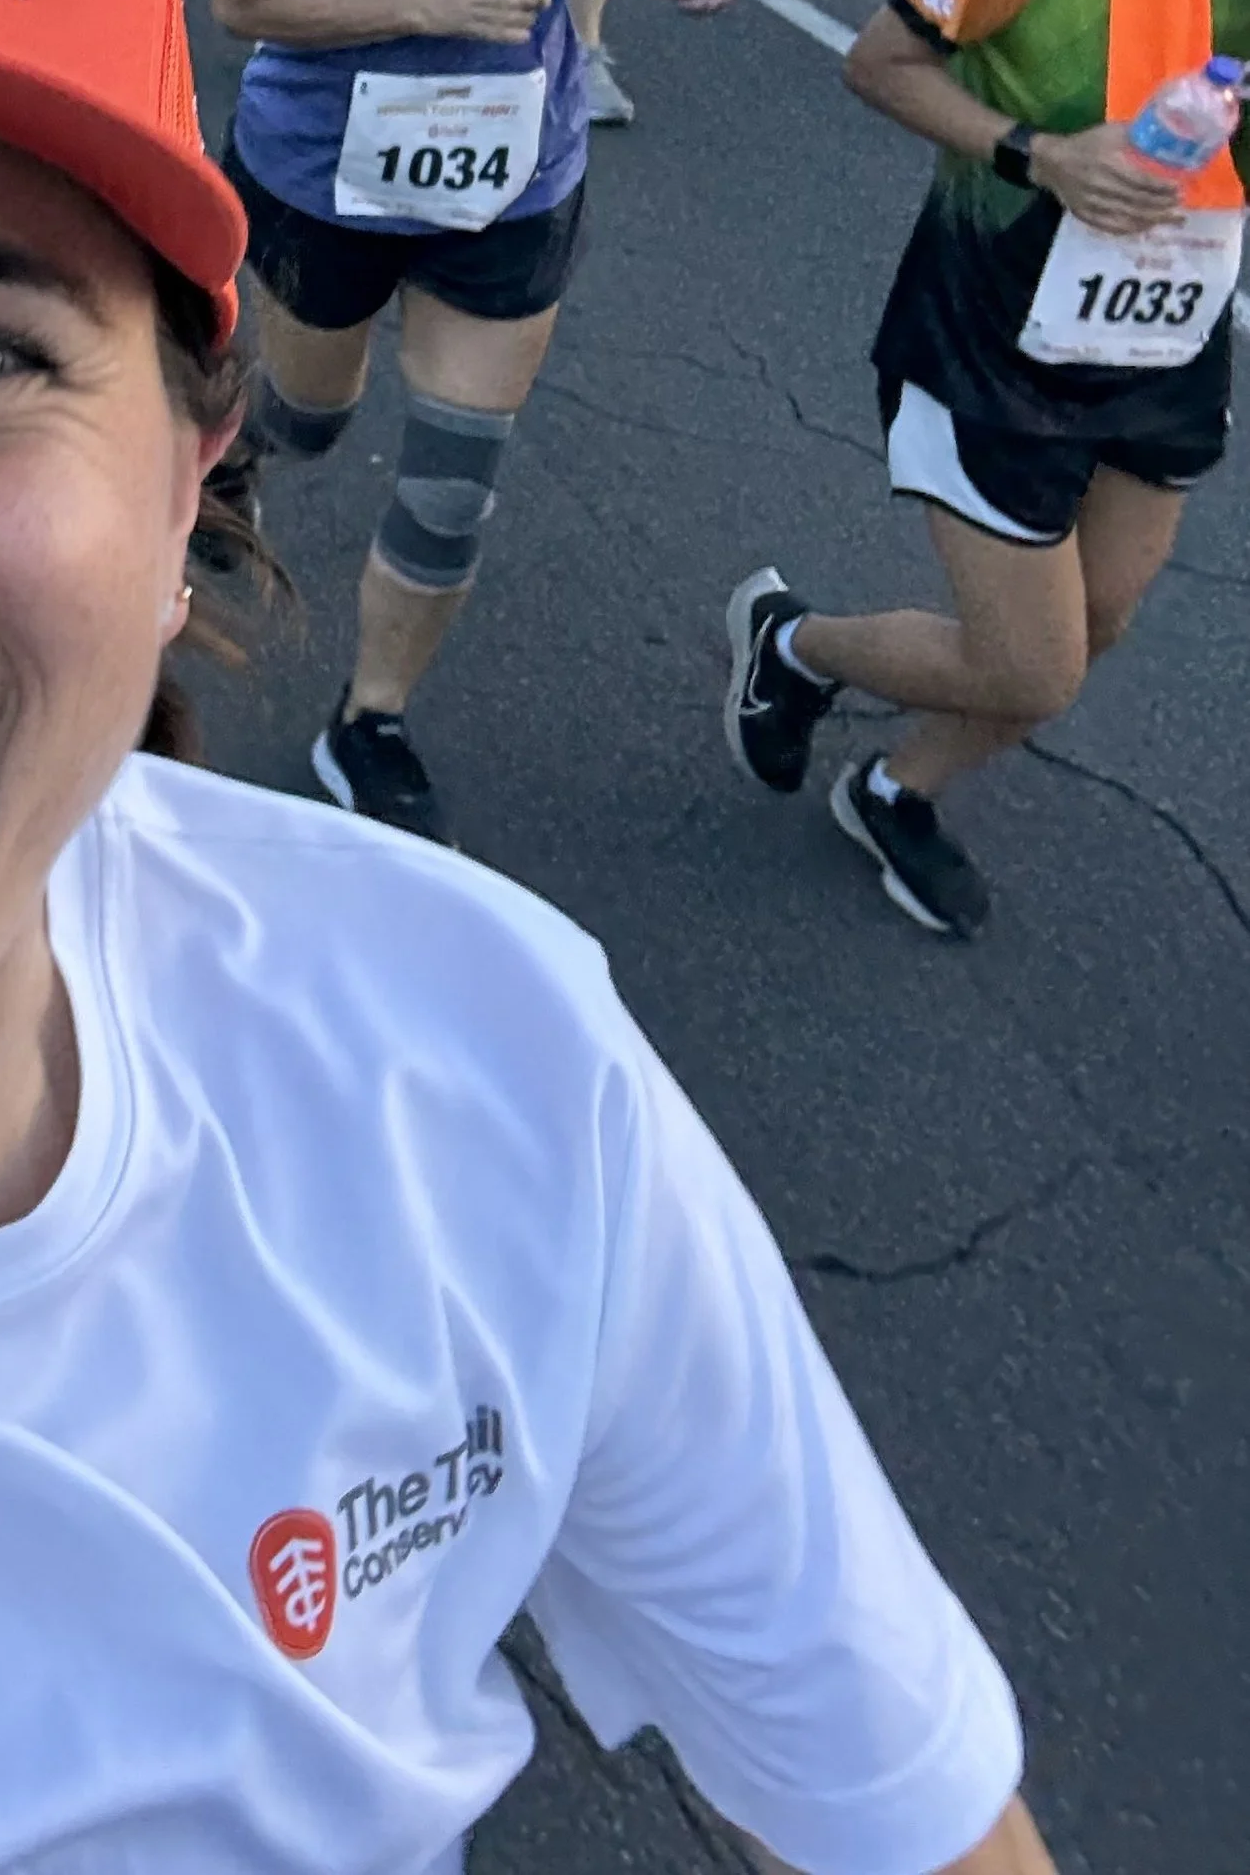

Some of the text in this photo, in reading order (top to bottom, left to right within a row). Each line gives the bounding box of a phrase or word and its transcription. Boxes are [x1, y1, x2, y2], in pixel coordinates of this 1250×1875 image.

[377, 145, 509, 191] 1034
[1077, 273, 1204, 325] 1033
[337, 1471, 431, 1554] The
